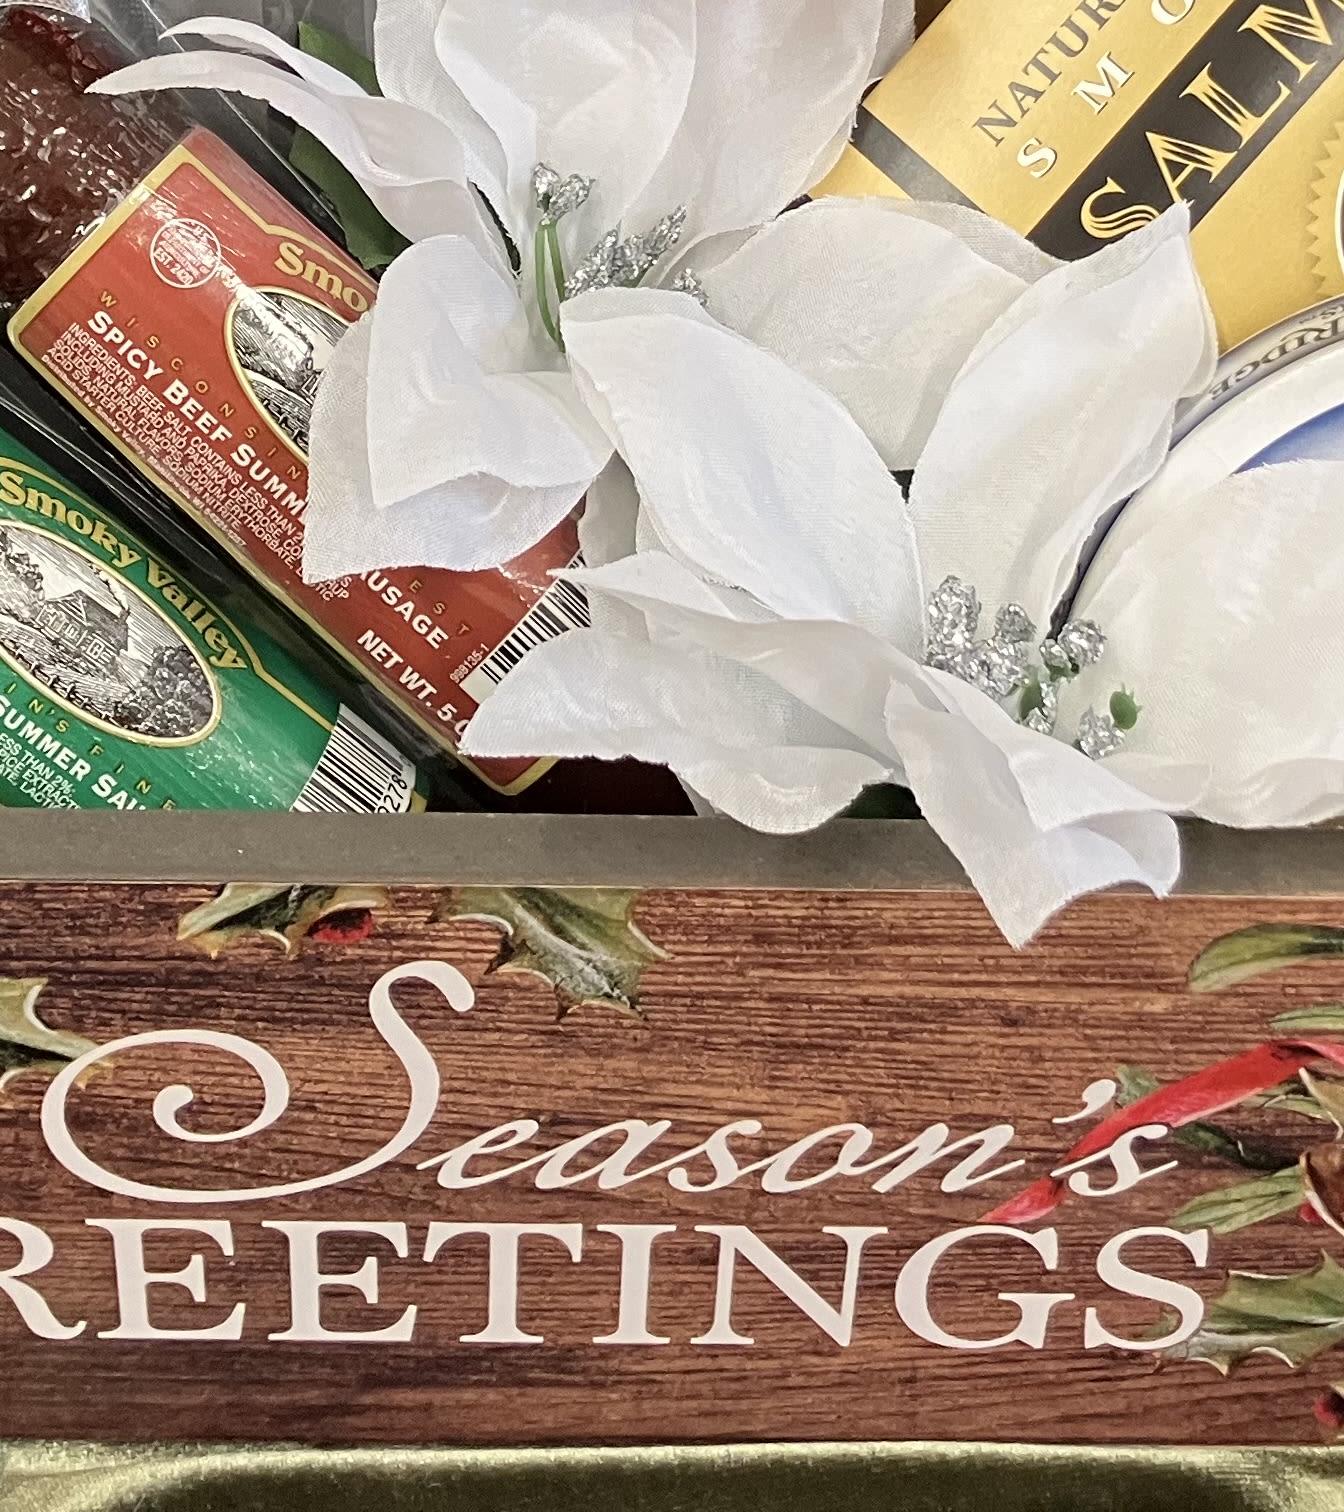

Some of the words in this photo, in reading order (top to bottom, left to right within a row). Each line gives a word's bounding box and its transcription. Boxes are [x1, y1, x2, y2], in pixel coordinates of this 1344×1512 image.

[272, 240, 369, 313] Smo
[45, 346, 74, 372] ACID
[70, 368, 117, 413] STARTER
[161, 454, 204, 495] SODIUM
[52, 338, 92, 380] SOLIDS,
[91, 374, 137, 421] NATURAL
[136, 416, 184, 465] FLAVORS,
[183, 460, 226, 503] SODIUM
[60, 330, 117, 385] INCLUDING
[113, 380, 164, 429] MUSTARD
[160, 426, 187, 450] AND
[183, 445, 227, 492] PAPRIKA,
[227, 486, 283, 543] DEXTROSE,
[67, 322, 137, 389] INGREDIENTS:
[189, 435, 242, 485] CONTAINS
[238, 480, 269, 510] LESS
[265, 504, 297, 536] THAN
[87, 310, 163, 379] SPICY
[162, 378, 232, 441] BEEF
[230, 443, 319, 525] SUMM
[359, 562, 448, 648] USAGE
[97, 289, 302, 482] WISCONSIN
[407, 577, 472, 640] EST
[145, 552, 247, 672] Valley
[356, 629, 404, 669] NET
[398, 665, 437, 707] WT.
[435, 702, 458, 722] 5
[20, 749, 55, 780] THAN
[40, 958, 1185, 1203] Season's
